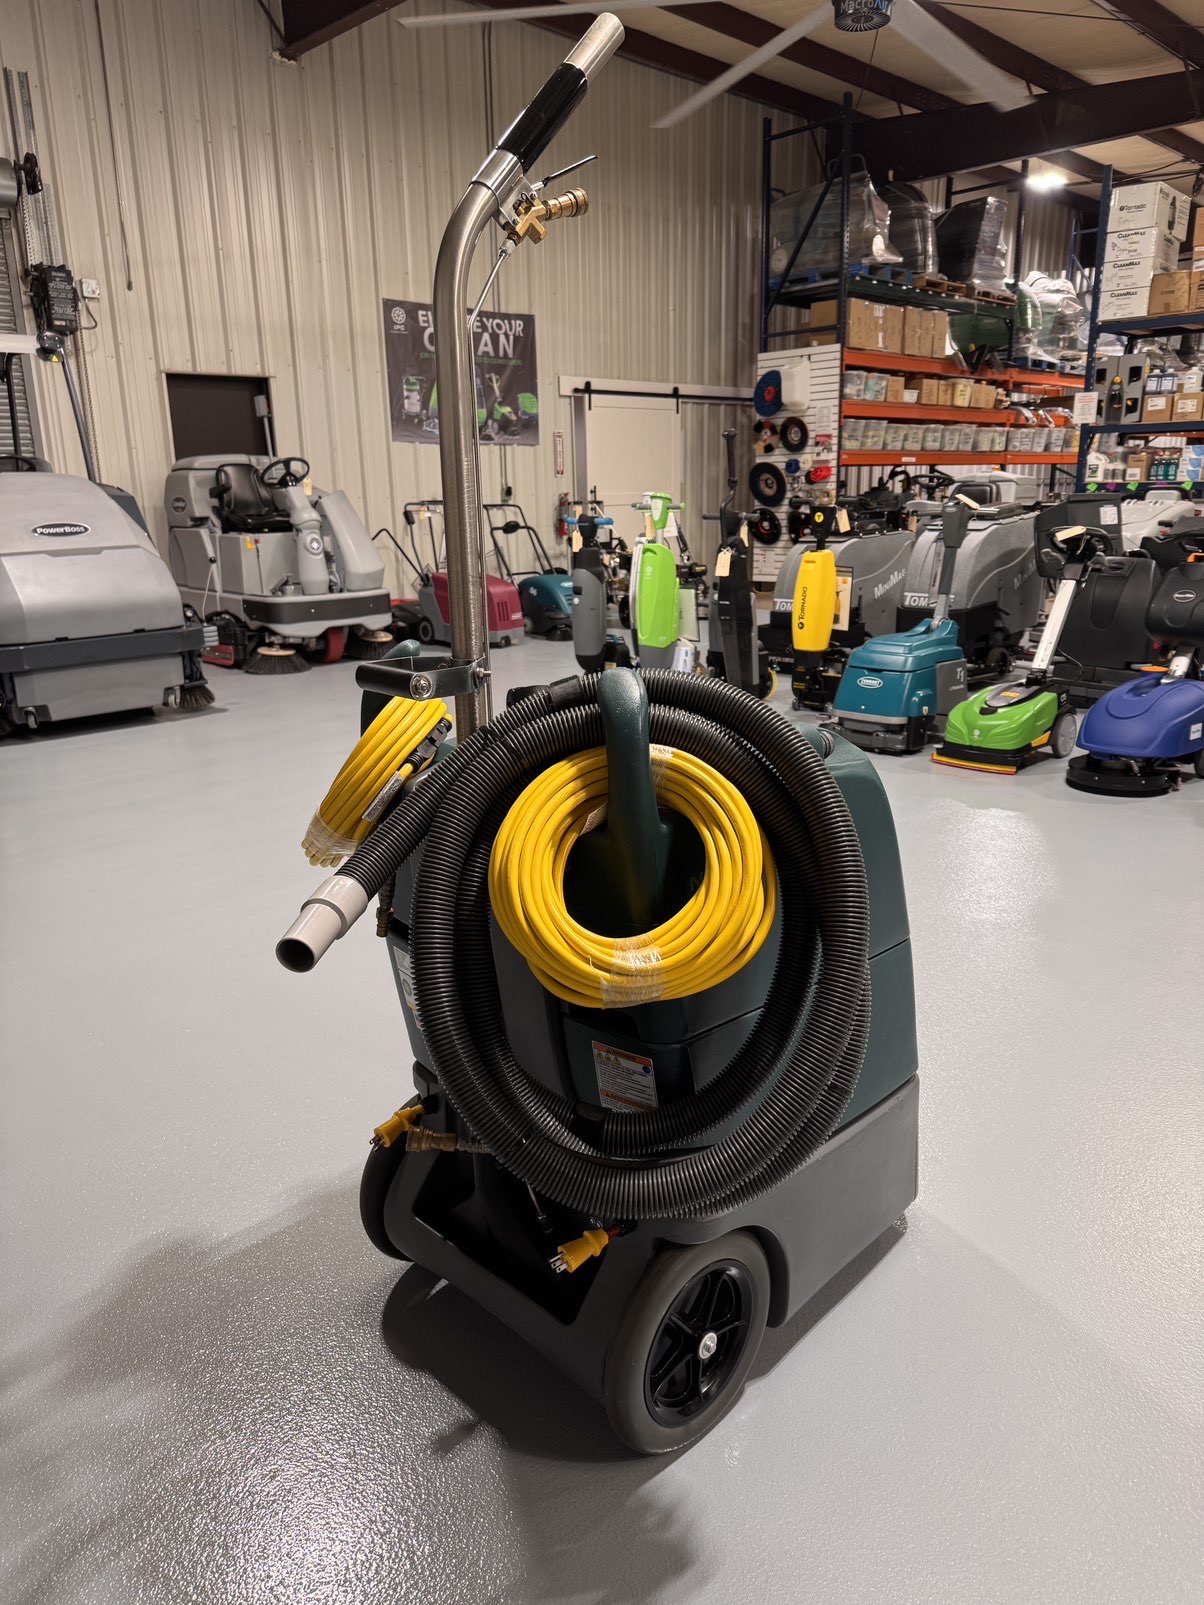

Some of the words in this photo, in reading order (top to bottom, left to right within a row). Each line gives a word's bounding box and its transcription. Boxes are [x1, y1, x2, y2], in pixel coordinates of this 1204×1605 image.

[840, 0, 888, 12] MacroAir
[1125, 203, 1147, 211] Tornado
[484, 317, 524, 337] YOUR
[423, 327, 514, 358] CAN
[36, 526, 85, 534] PowerBoss
[798, 586, 808, 620] TORNADO
